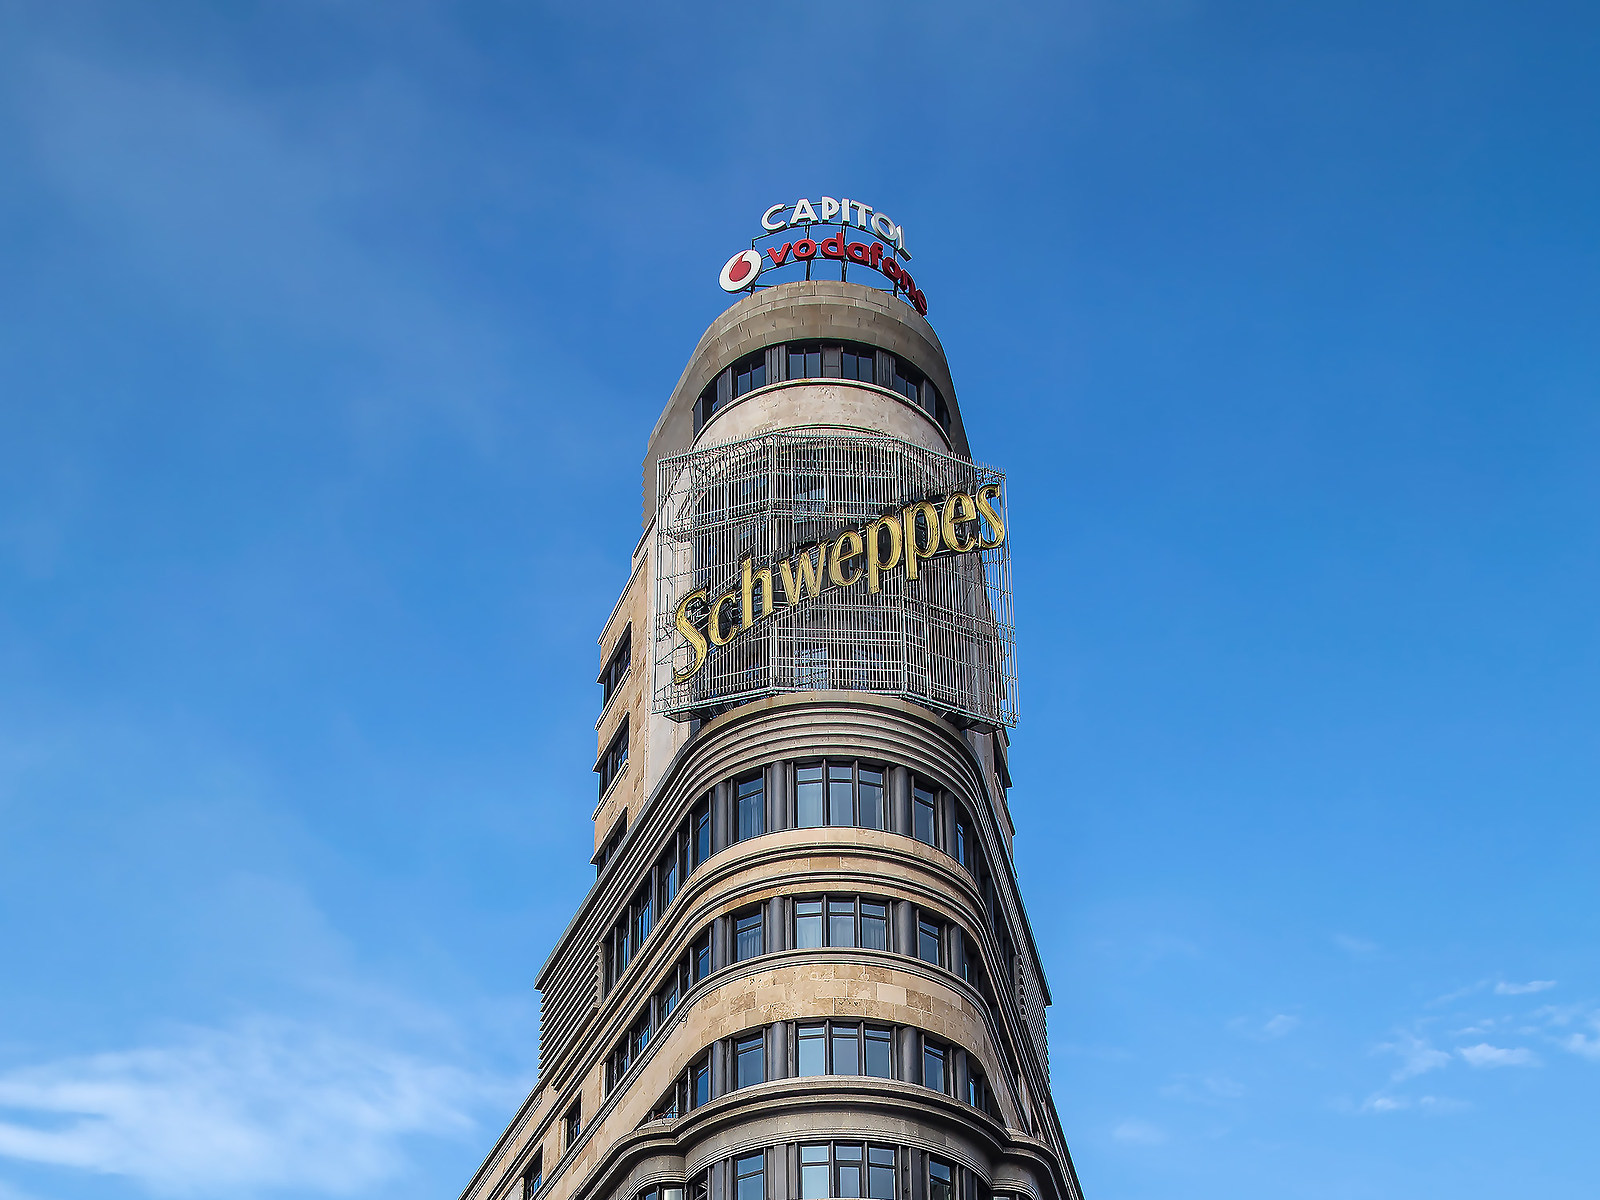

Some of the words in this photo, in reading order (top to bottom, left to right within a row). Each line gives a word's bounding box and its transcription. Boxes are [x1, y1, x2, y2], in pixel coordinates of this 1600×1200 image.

[761, 196, 913, 262] CAPITOL
[767, 232, 928, 316] vodafone
[672, 483, 1006, 684] Schweppes
